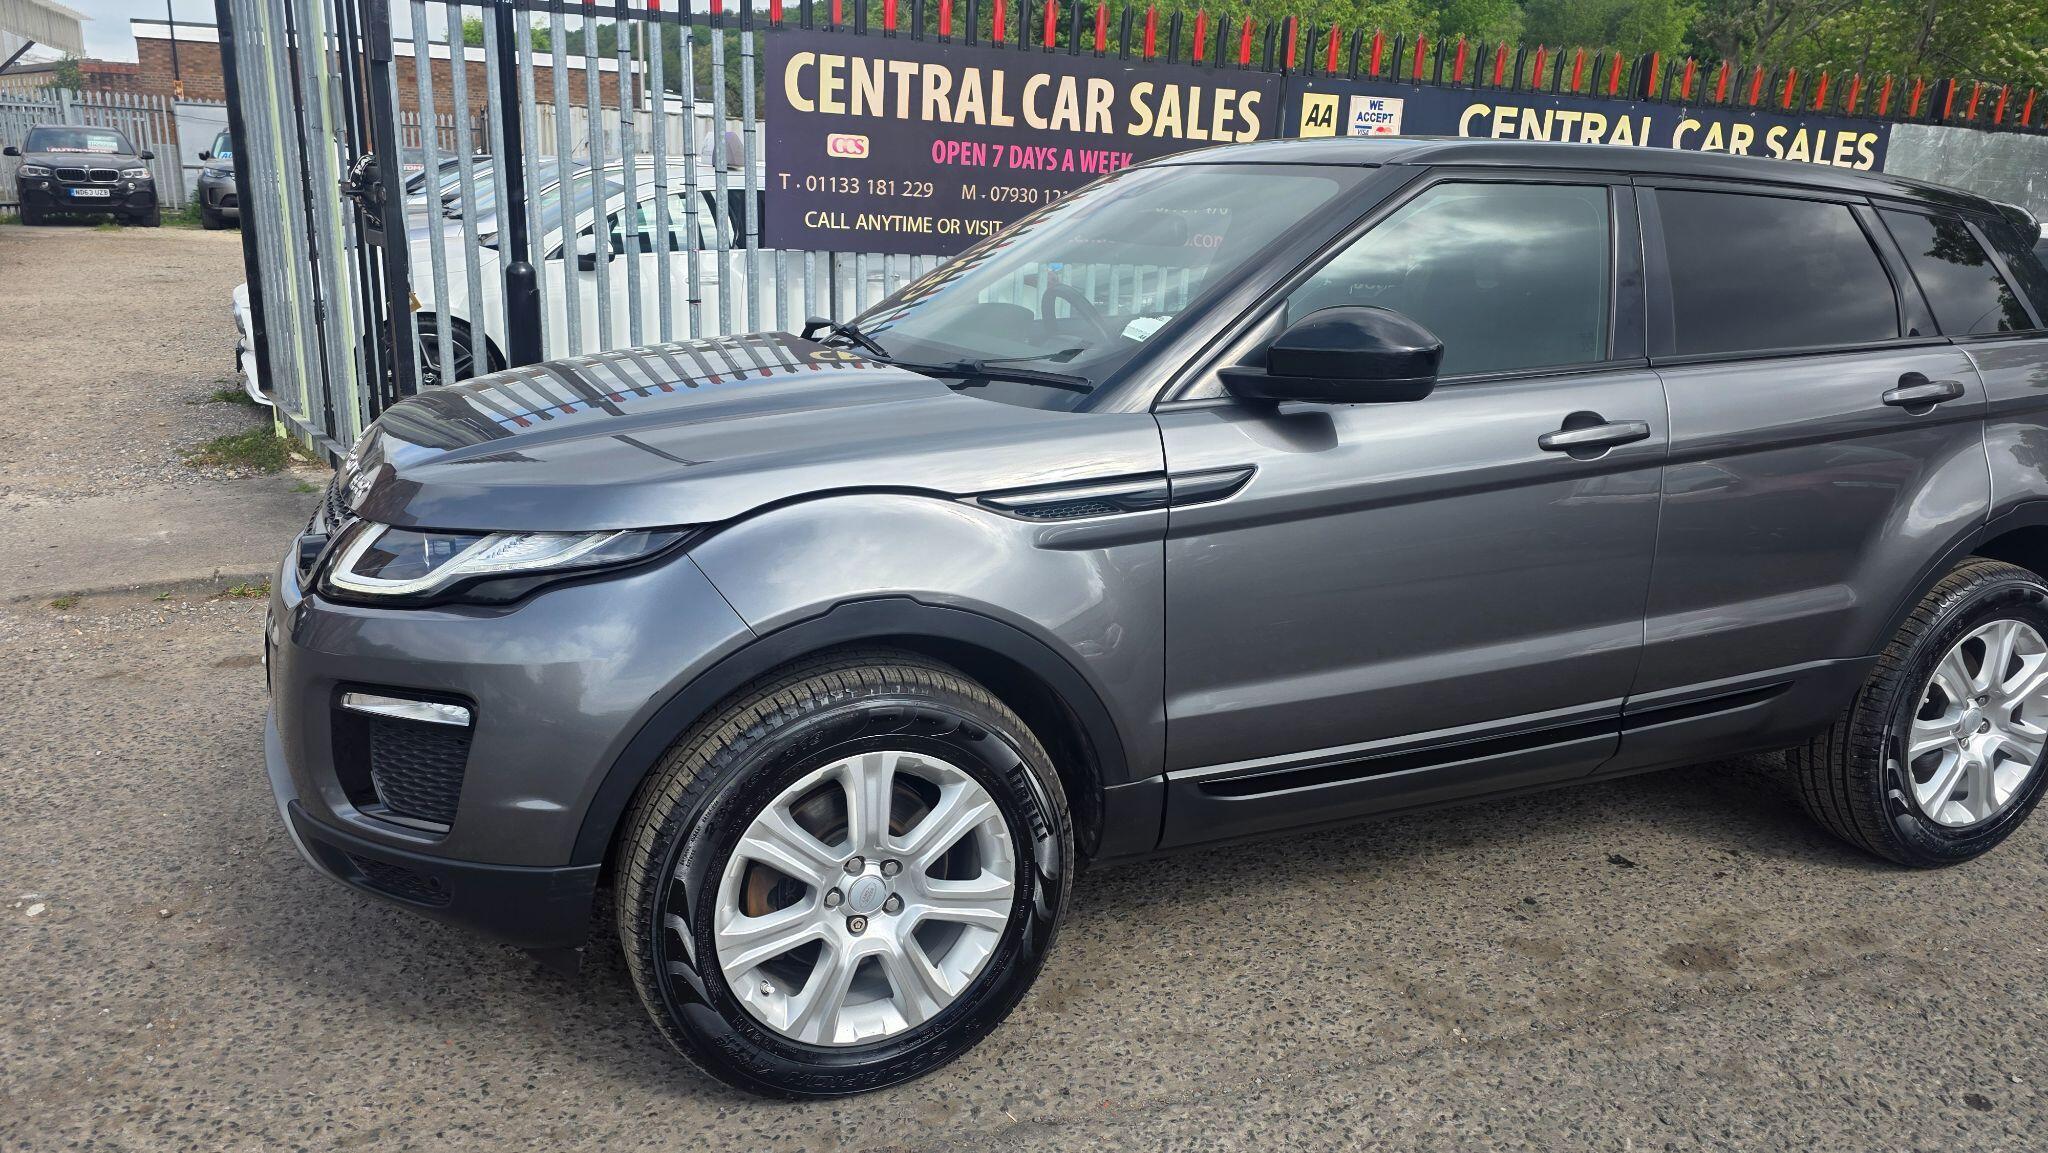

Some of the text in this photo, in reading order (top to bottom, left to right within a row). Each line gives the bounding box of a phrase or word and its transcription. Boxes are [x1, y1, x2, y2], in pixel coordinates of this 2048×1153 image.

[784, 51, 1262, 143] CENTRAL CAR SALES
[1369, 99, 1384, 111] WE
[1304, 103, 1333, 127] AA
[1356, 111, 1394, 123] ACCEPT
[1458, 103, 1879, 171] CENTRAL CAR SALES
[931, 139, 1134, 174] OPEN 7 DAYS A WEEK
[805, 175, 860, 194] 01133
[867, 179, 895, 196] 181
[900, 180, 934, 198] 229
[990, 186, 1038, 204] 07930
[1044, 189, 1068, 204] 12
[804, 210, 1003, 236] CALL ANYTIME OR VISIT
